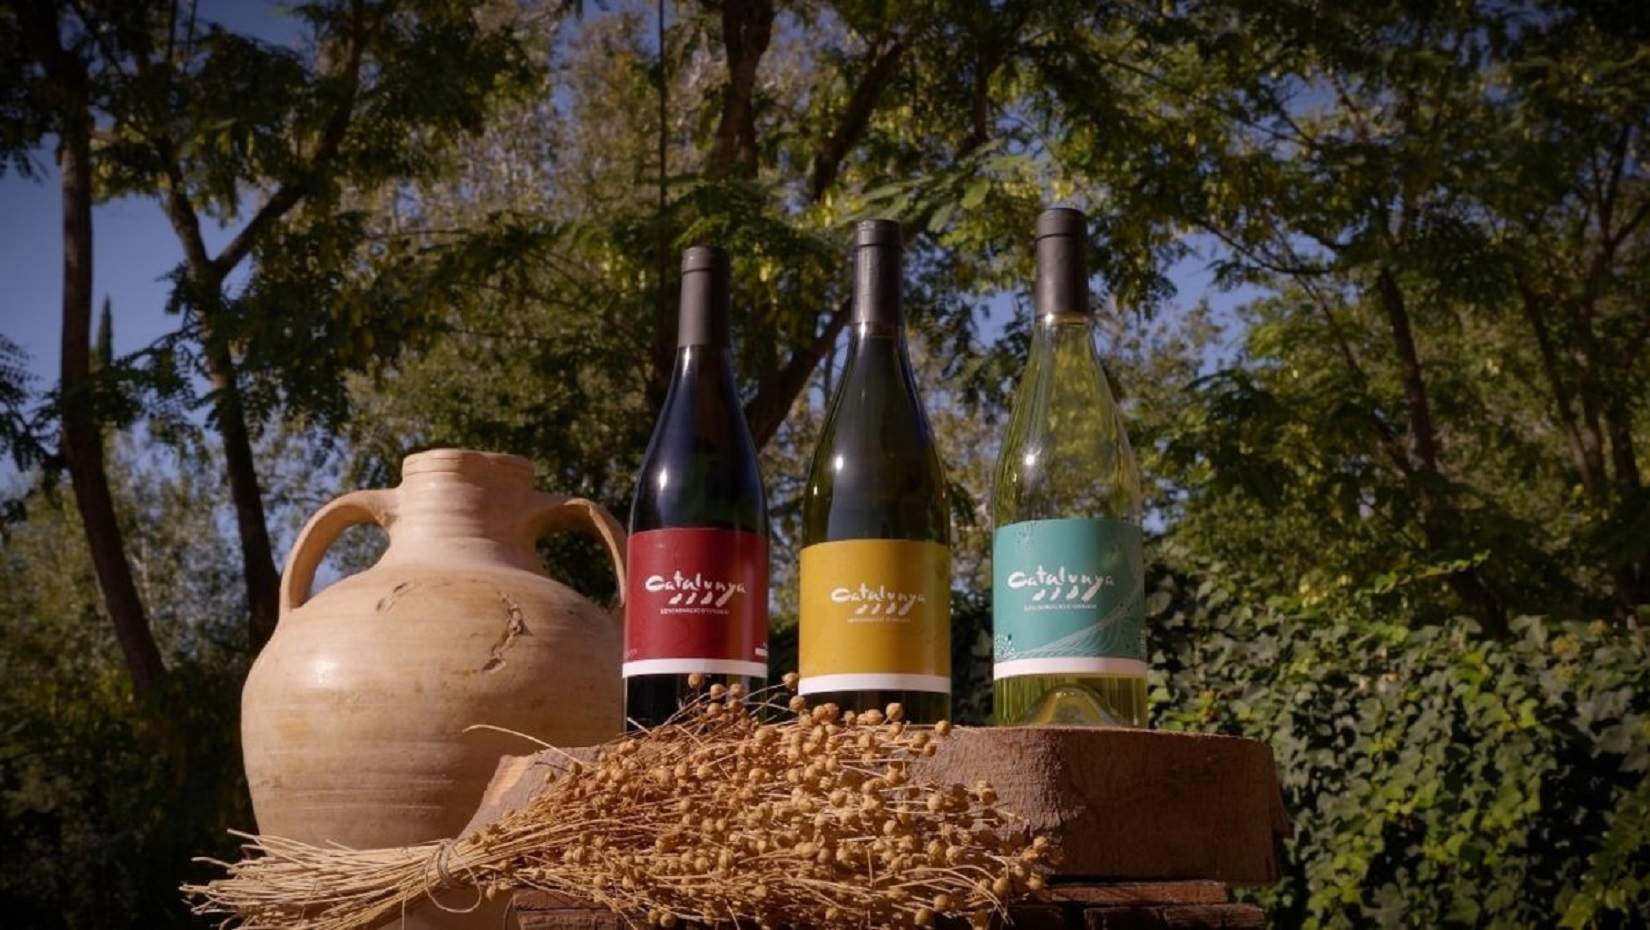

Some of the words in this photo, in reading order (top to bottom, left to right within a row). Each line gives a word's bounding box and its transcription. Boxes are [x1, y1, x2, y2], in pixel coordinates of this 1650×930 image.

[645, 570, 747, 608] Catalunya
[831, 582, 927, 616] Catalunya
[1007, 565, 1115, 602] Catalunya
